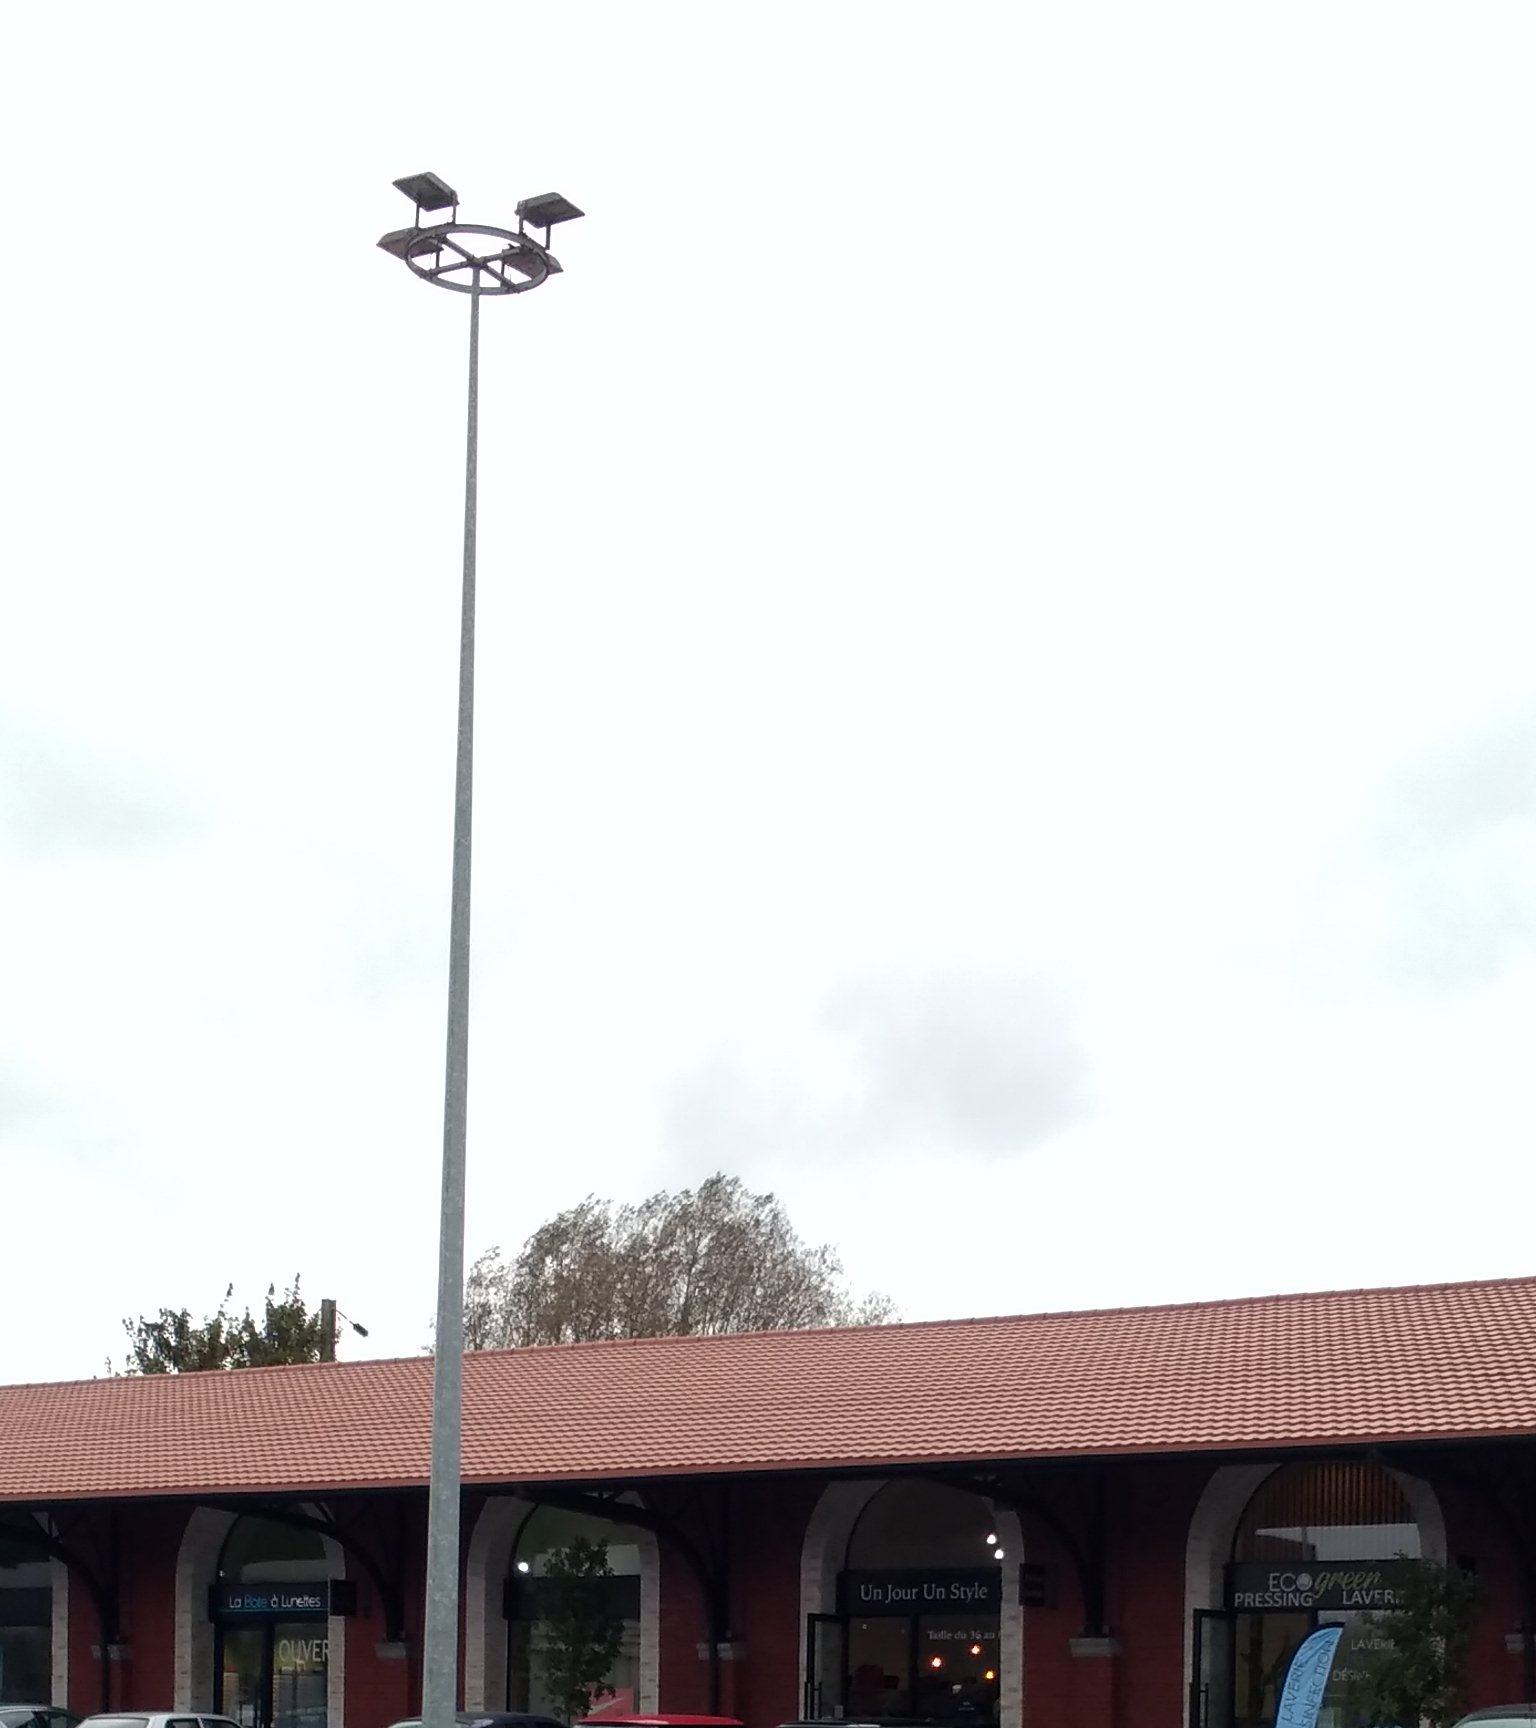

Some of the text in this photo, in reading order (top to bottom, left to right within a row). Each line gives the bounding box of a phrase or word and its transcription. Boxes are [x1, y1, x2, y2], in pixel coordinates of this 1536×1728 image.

[860, 1581, 988, 1604] Un Jour Un Style
[1267, 1570, 1383, 1599] ECO green
[229, 1594, 241, 1609] La
[281, 1594, 321, 1608] Lunettes
[1233, 1591, 1314, 1608] PRESSING
